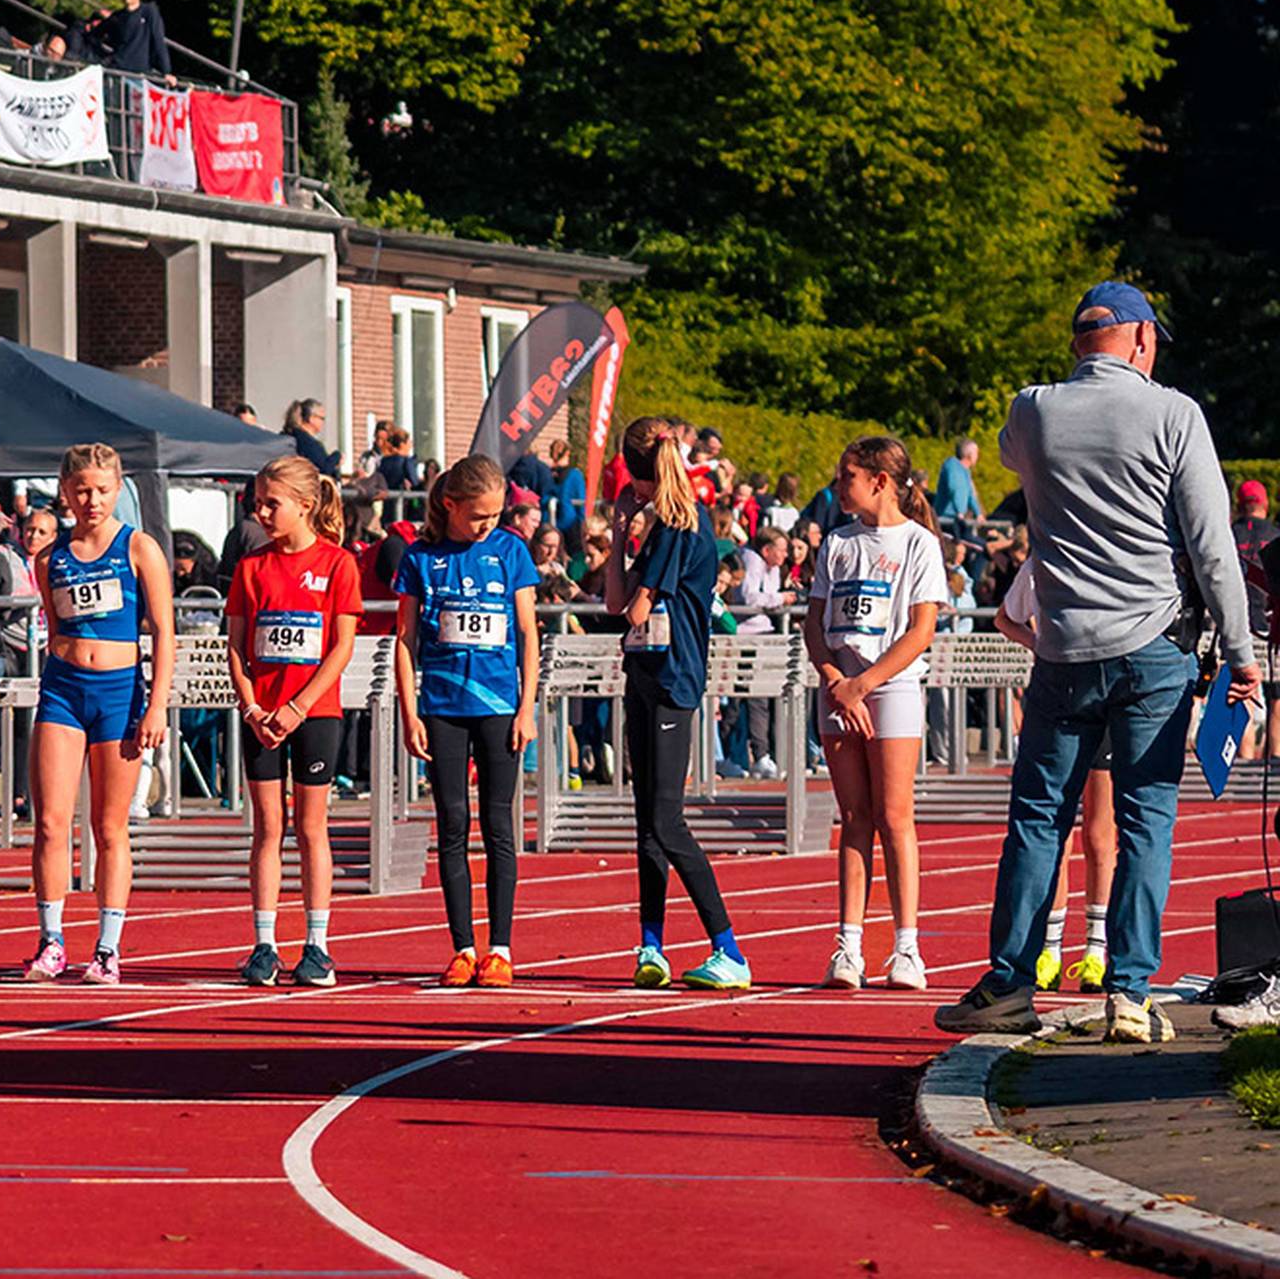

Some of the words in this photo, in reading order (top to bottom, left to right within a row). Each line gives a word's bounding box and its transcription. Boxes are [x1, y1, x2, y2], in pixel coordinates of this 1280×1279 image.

[67, 583, 102, 605] 191
[841, 597, 872, 616] 495
[457, 613, 491, 633] 181
[268, 627, 305, 647] 494
